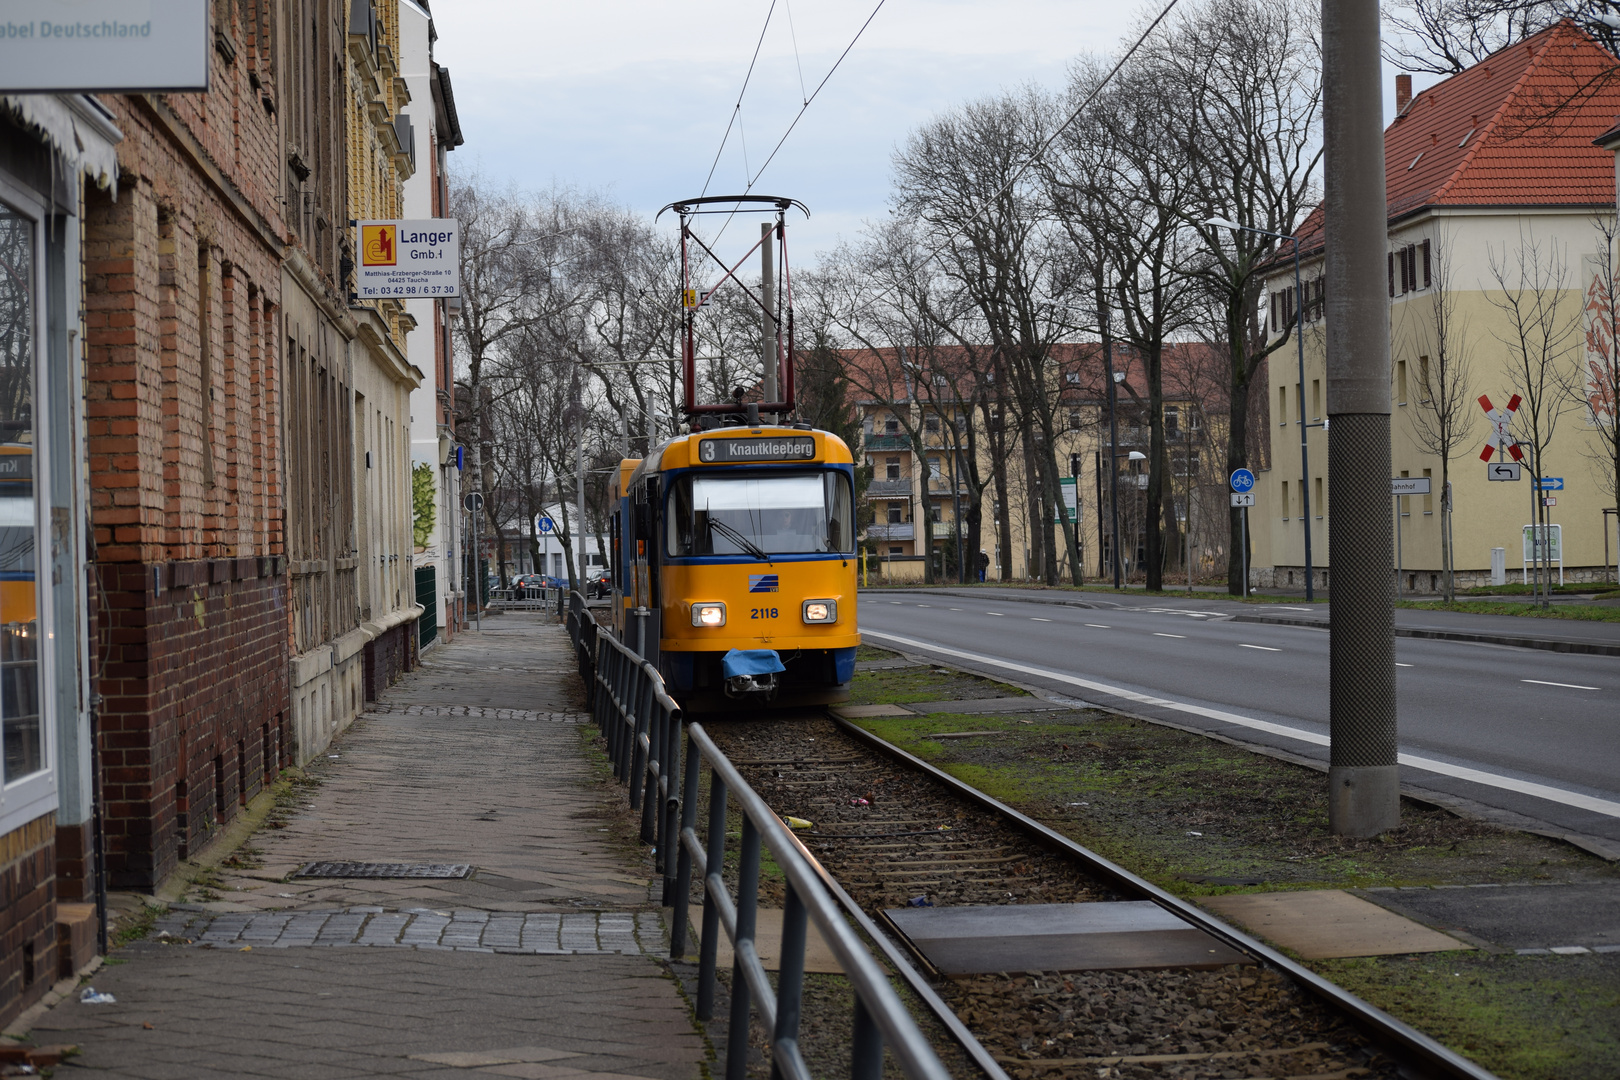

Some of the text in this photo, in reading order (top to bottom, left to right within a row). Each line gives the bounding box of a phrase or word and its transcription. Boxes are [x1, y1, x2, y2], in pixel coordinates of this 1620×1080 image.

[40, 20, 151, 38] Deutschland
[401, 230, 453, 246] Langer
[363, 287, 378, 295] Tel:
[381, 286, 391, 294] 03
[393, 286, 404, 294] 42
[406, 286, 416, 294] 98
[423, 286, 429, 294] 6
[444, 285, 454, 293] 30
[705, 441, 813, 461] 3 Knautkleeberg
[751, 607, 779, 620] 2118
